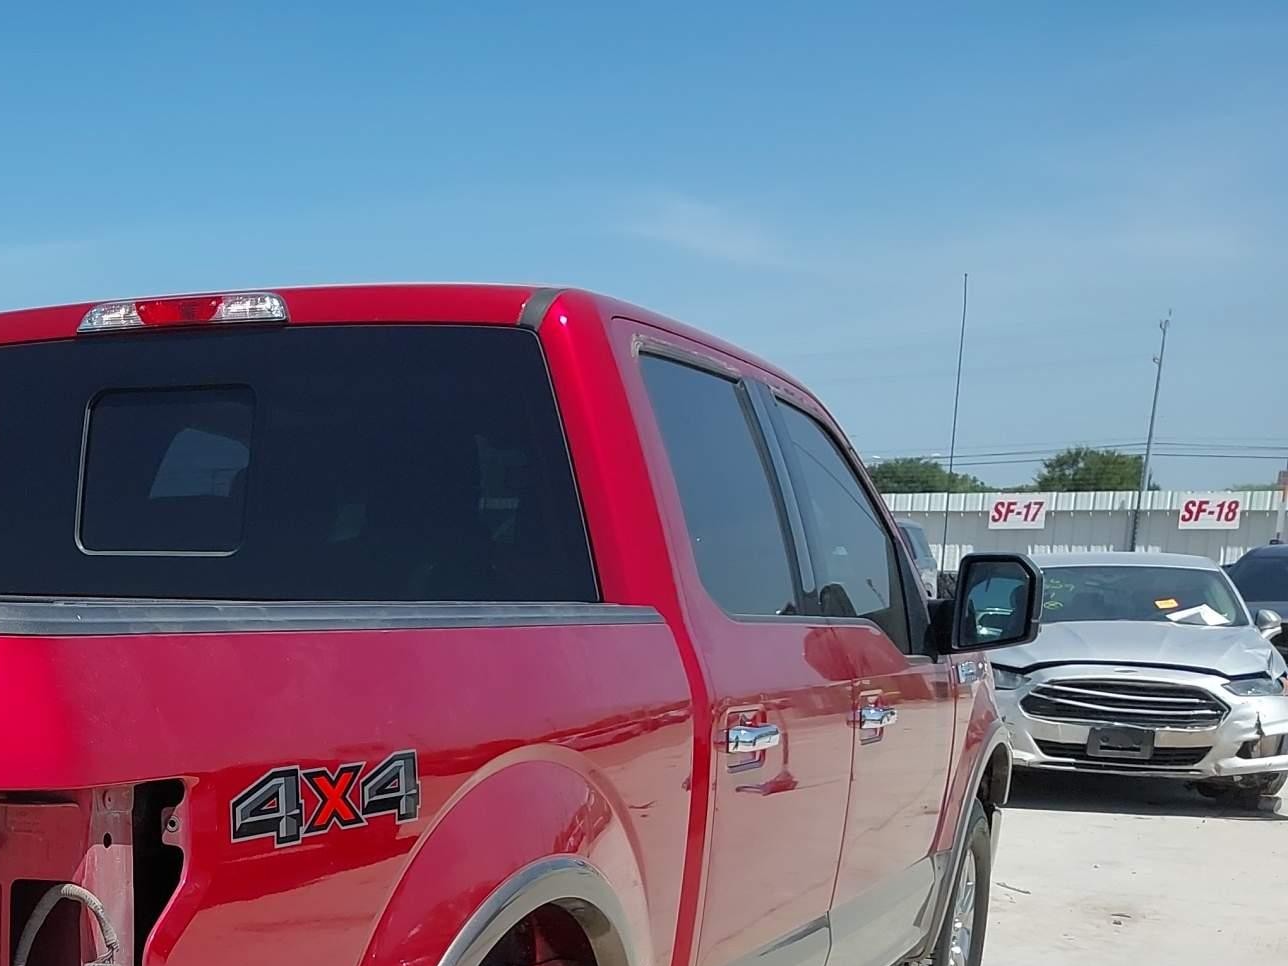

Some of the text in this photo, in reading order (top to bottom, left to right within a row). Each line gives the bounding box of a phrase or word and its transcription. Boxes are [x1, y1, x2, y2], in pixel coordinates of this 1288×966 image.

[991, 501, 1045, 523] SF-17
[1180, 500, 1241, 523] SF-18
[230, 749, 421, 848] 4X4
